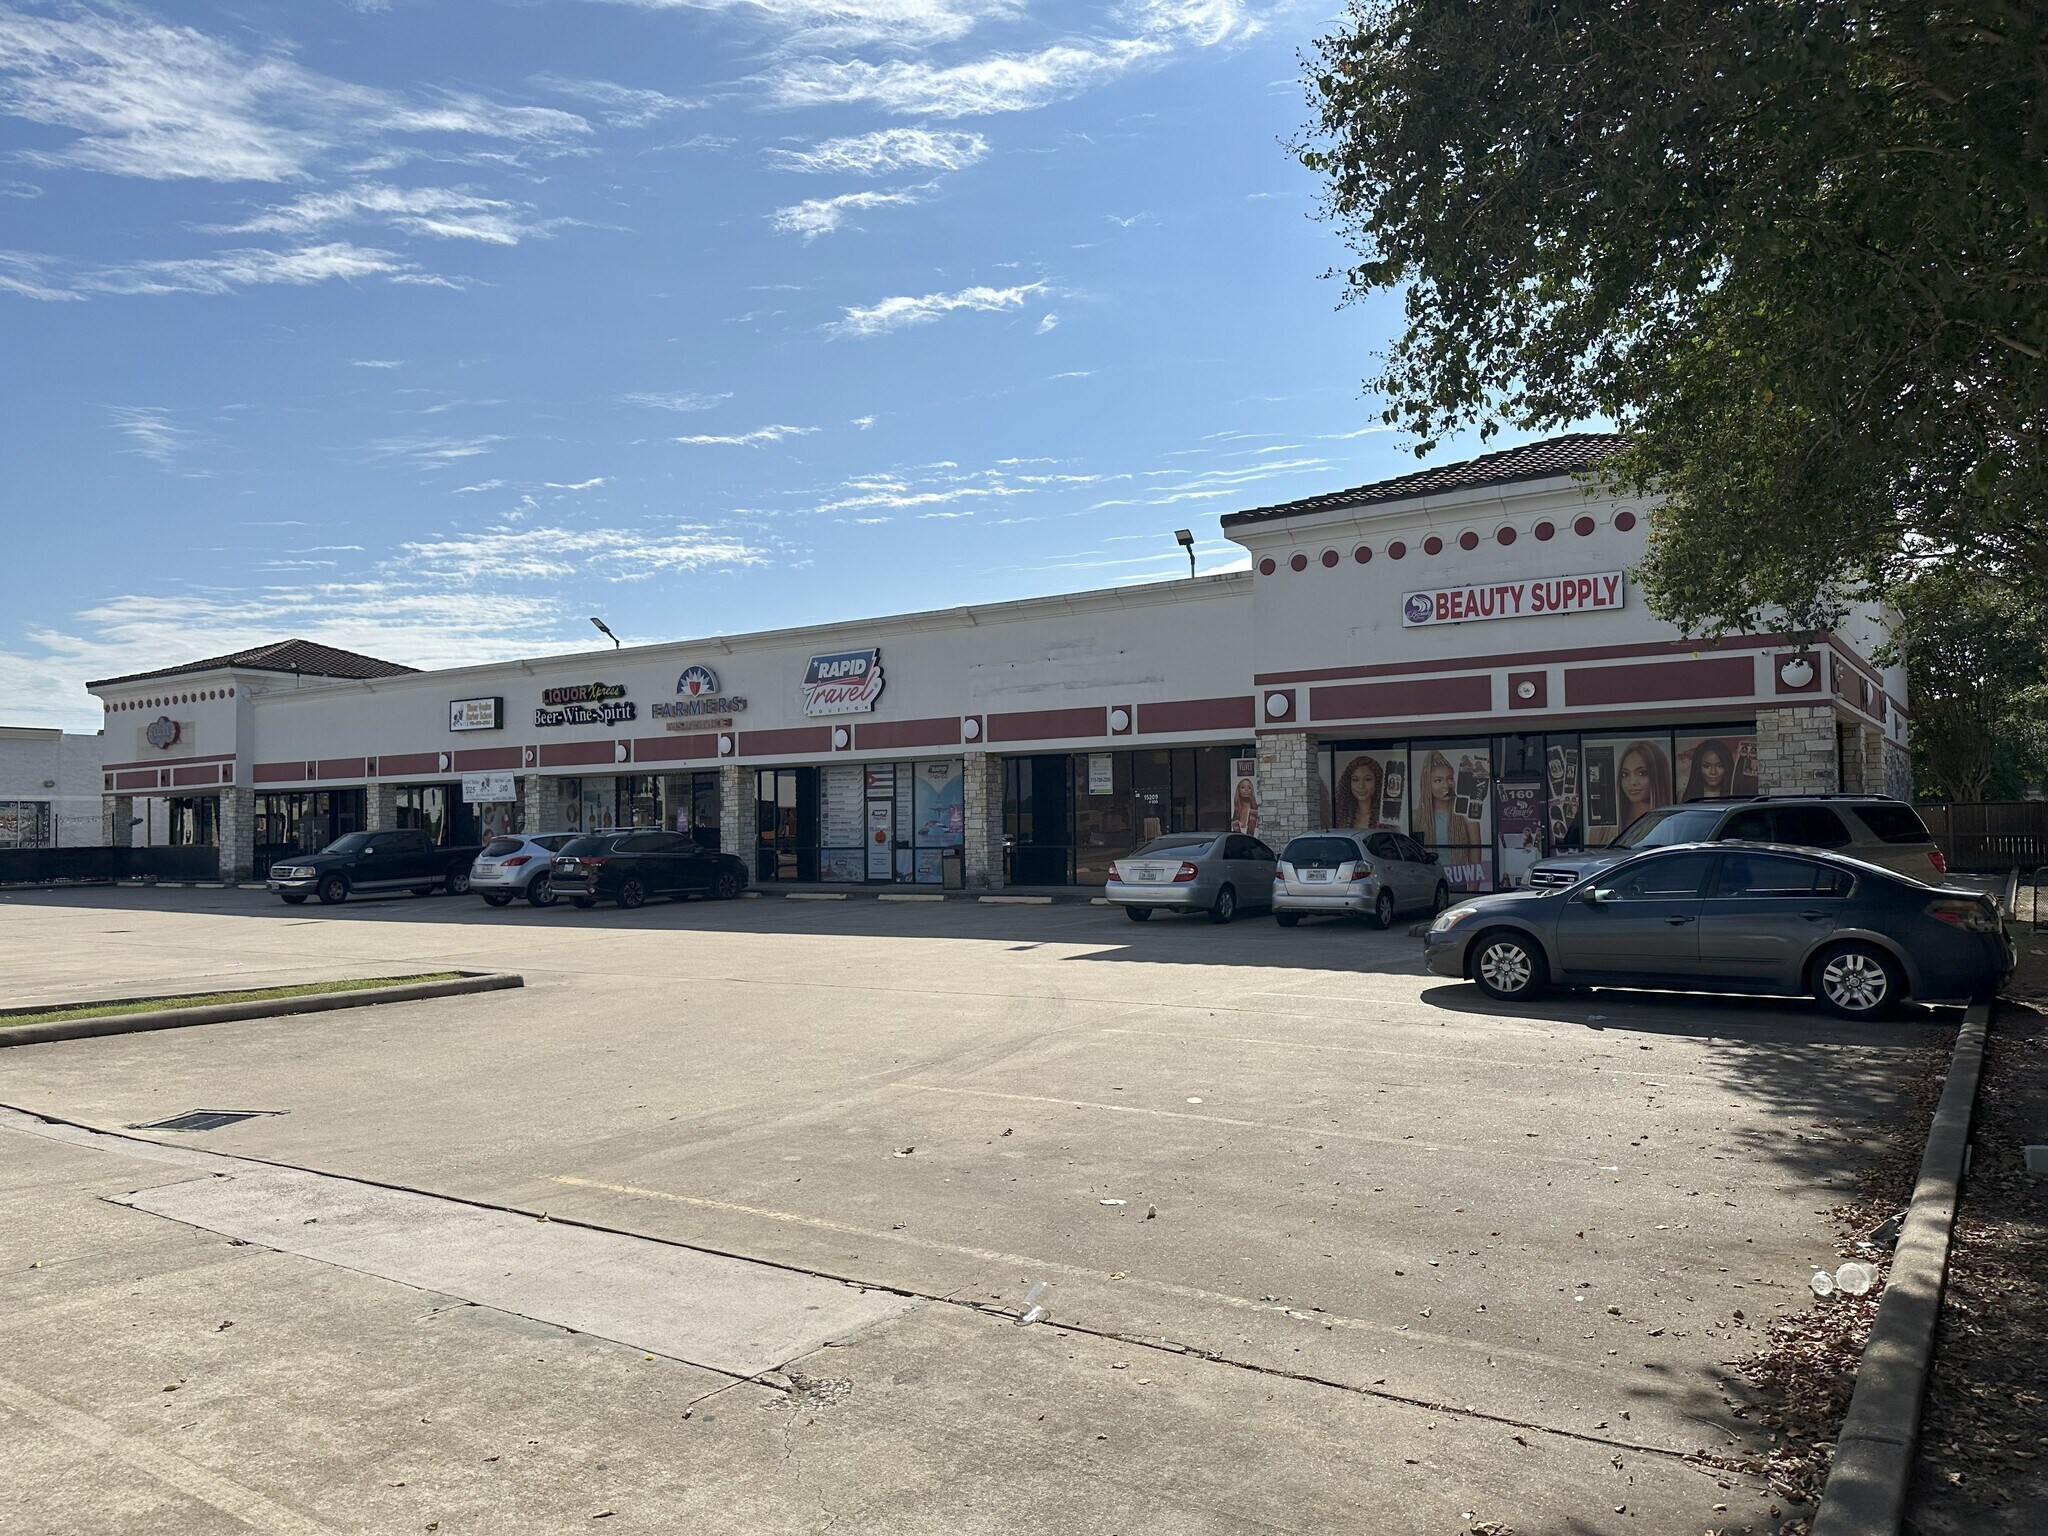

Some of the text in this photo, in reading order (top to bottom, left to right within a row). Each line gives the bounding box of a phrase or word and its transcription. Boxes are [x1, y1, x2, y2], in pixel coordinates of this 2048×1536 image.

[1435, 575, 1620, 621] BEAUTY SUPPLY
[817, 658, 867, 679] RAPID
[542, 683, 620, 703] LIQUOR Xpress
[534, 704, 632, 725] Beer-Wine-Spirit
[651, 696, 741, 719] FARMERS
[1508, 790, 1534, 799] 160
[1443, 863, 1486, 883] RUWA
